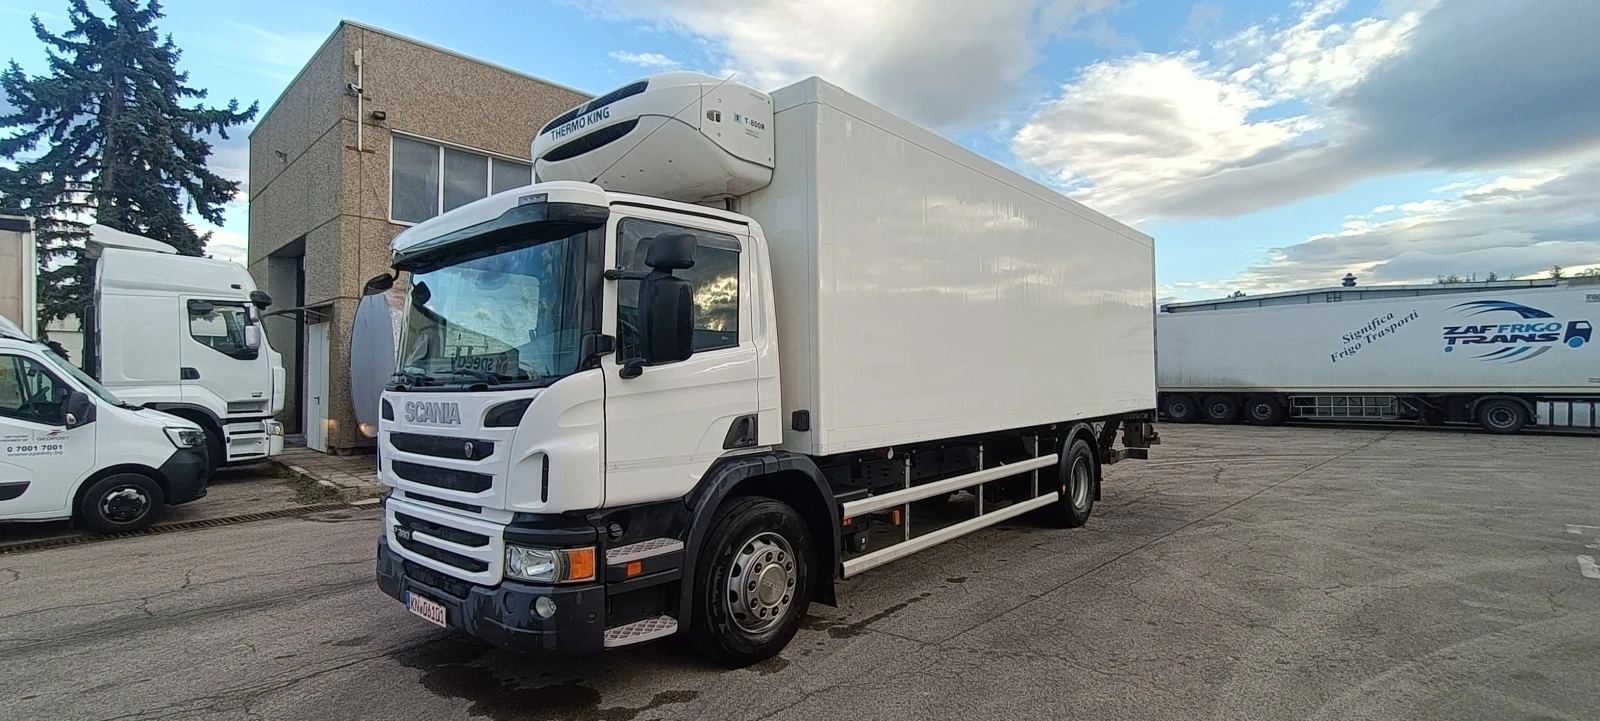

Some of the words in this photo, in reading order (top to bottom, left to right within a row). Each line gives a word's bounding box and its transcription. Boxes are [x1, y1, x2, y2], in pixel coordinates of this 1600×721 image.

[551, 117, 586, 141] THERMO
[587, 106, 610, 126] KING
[1330, 342, 1362, 363] Frigo
[1363, 309, 1419, 344] Trasporti
[1342, 312, 1394, 345] Significa
[1443, 333, 1560, 345] TRANS
[405, 401, 461, 424] SCANIA
